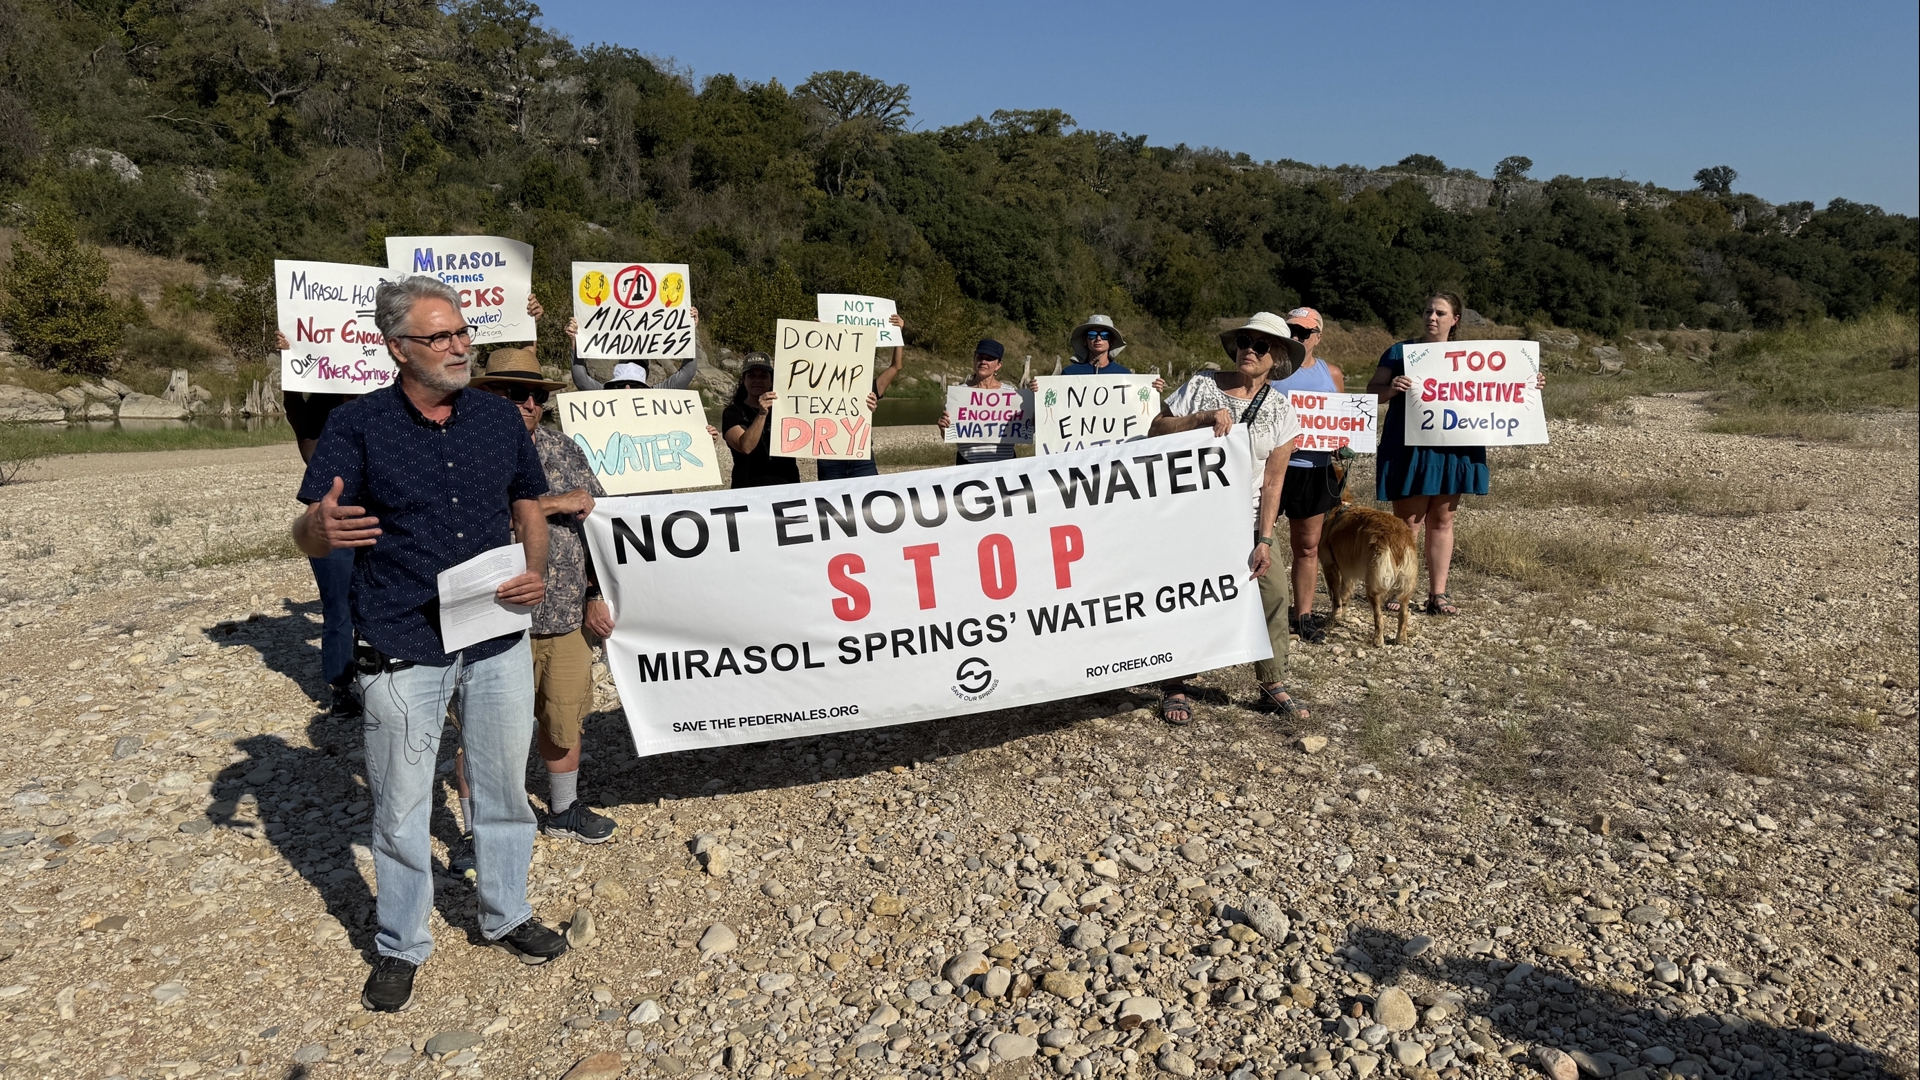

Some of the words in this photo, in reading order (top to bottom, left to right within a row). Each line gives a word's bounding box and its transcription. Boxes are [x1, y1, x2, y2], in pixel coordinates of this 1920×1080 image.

[413, 247, 506, 272] MIRASOL
[289, 271, 348, 301] MIRASOL
[437, 272, 485, 284] SPRINGS
[458, 286, 505, 308] CKS
[844, 300, 875, 313] NOT
[467, 308, 502, 325] water)
[584, 306, 691, 331] MIRASOL
[836, 314, 885, 328] ENOUGH
[296, 317, 335, 344] NOT
[341, 319, 385, 345] ENOUG
[583, 331, 692, 356] MADNESS
[783, 326, 864, 353] DON'T
[362, 345, 377, 357] for
[1444, 350, 1506, 371] TOO
[787, 359, 864, 393] PUMP
[970, 391, 1016, 407] NOT
[1068, 384, 1132, 408] NOT
[1291, 394, 1328, 410] NOT
[1421, 377, 1526, 403] SENSITIVE
[569, 398, 618, 422] NOT
[632, 397, 695, 417] ENUF
[787, 395, 860, 417] TEXAS
[958, 407, 1024, 422] ENOUGH
[1059, 415, 1137, 439] ENUF
[1421, 410, 1434, 430] 2
[1442, 409, 1519, 437] Develop
[780, 415, 871, 458] DRY!
[573, 430, 704, 476] WATER
[610, 505, 749, 565] NOT
[771, 474, 1037, 546] ENOUGH
[1048, 446, 1231, 509] WATER
[827, 524, 1085, 622] STOP
[637, 641, 826, 683] MIRASOL
[837, 612, 1016, 665] SPRINGS'
[1027, 592, 1146, 636] WATER
[1155, 573, 1239, 613] GRAB
[1086, 664, 1110, 678] ROY
[1111, 652, 1173, 673] CREEK.ORG
[951, 685, 964, 699] SAVE
[978, 678, 1000, 700] SPRINGS
[672, 720, 707, 733] SAVE
[709, 717, 737, 730] THE
[738, 704, 860, 727] PEDERNALES.ORG
